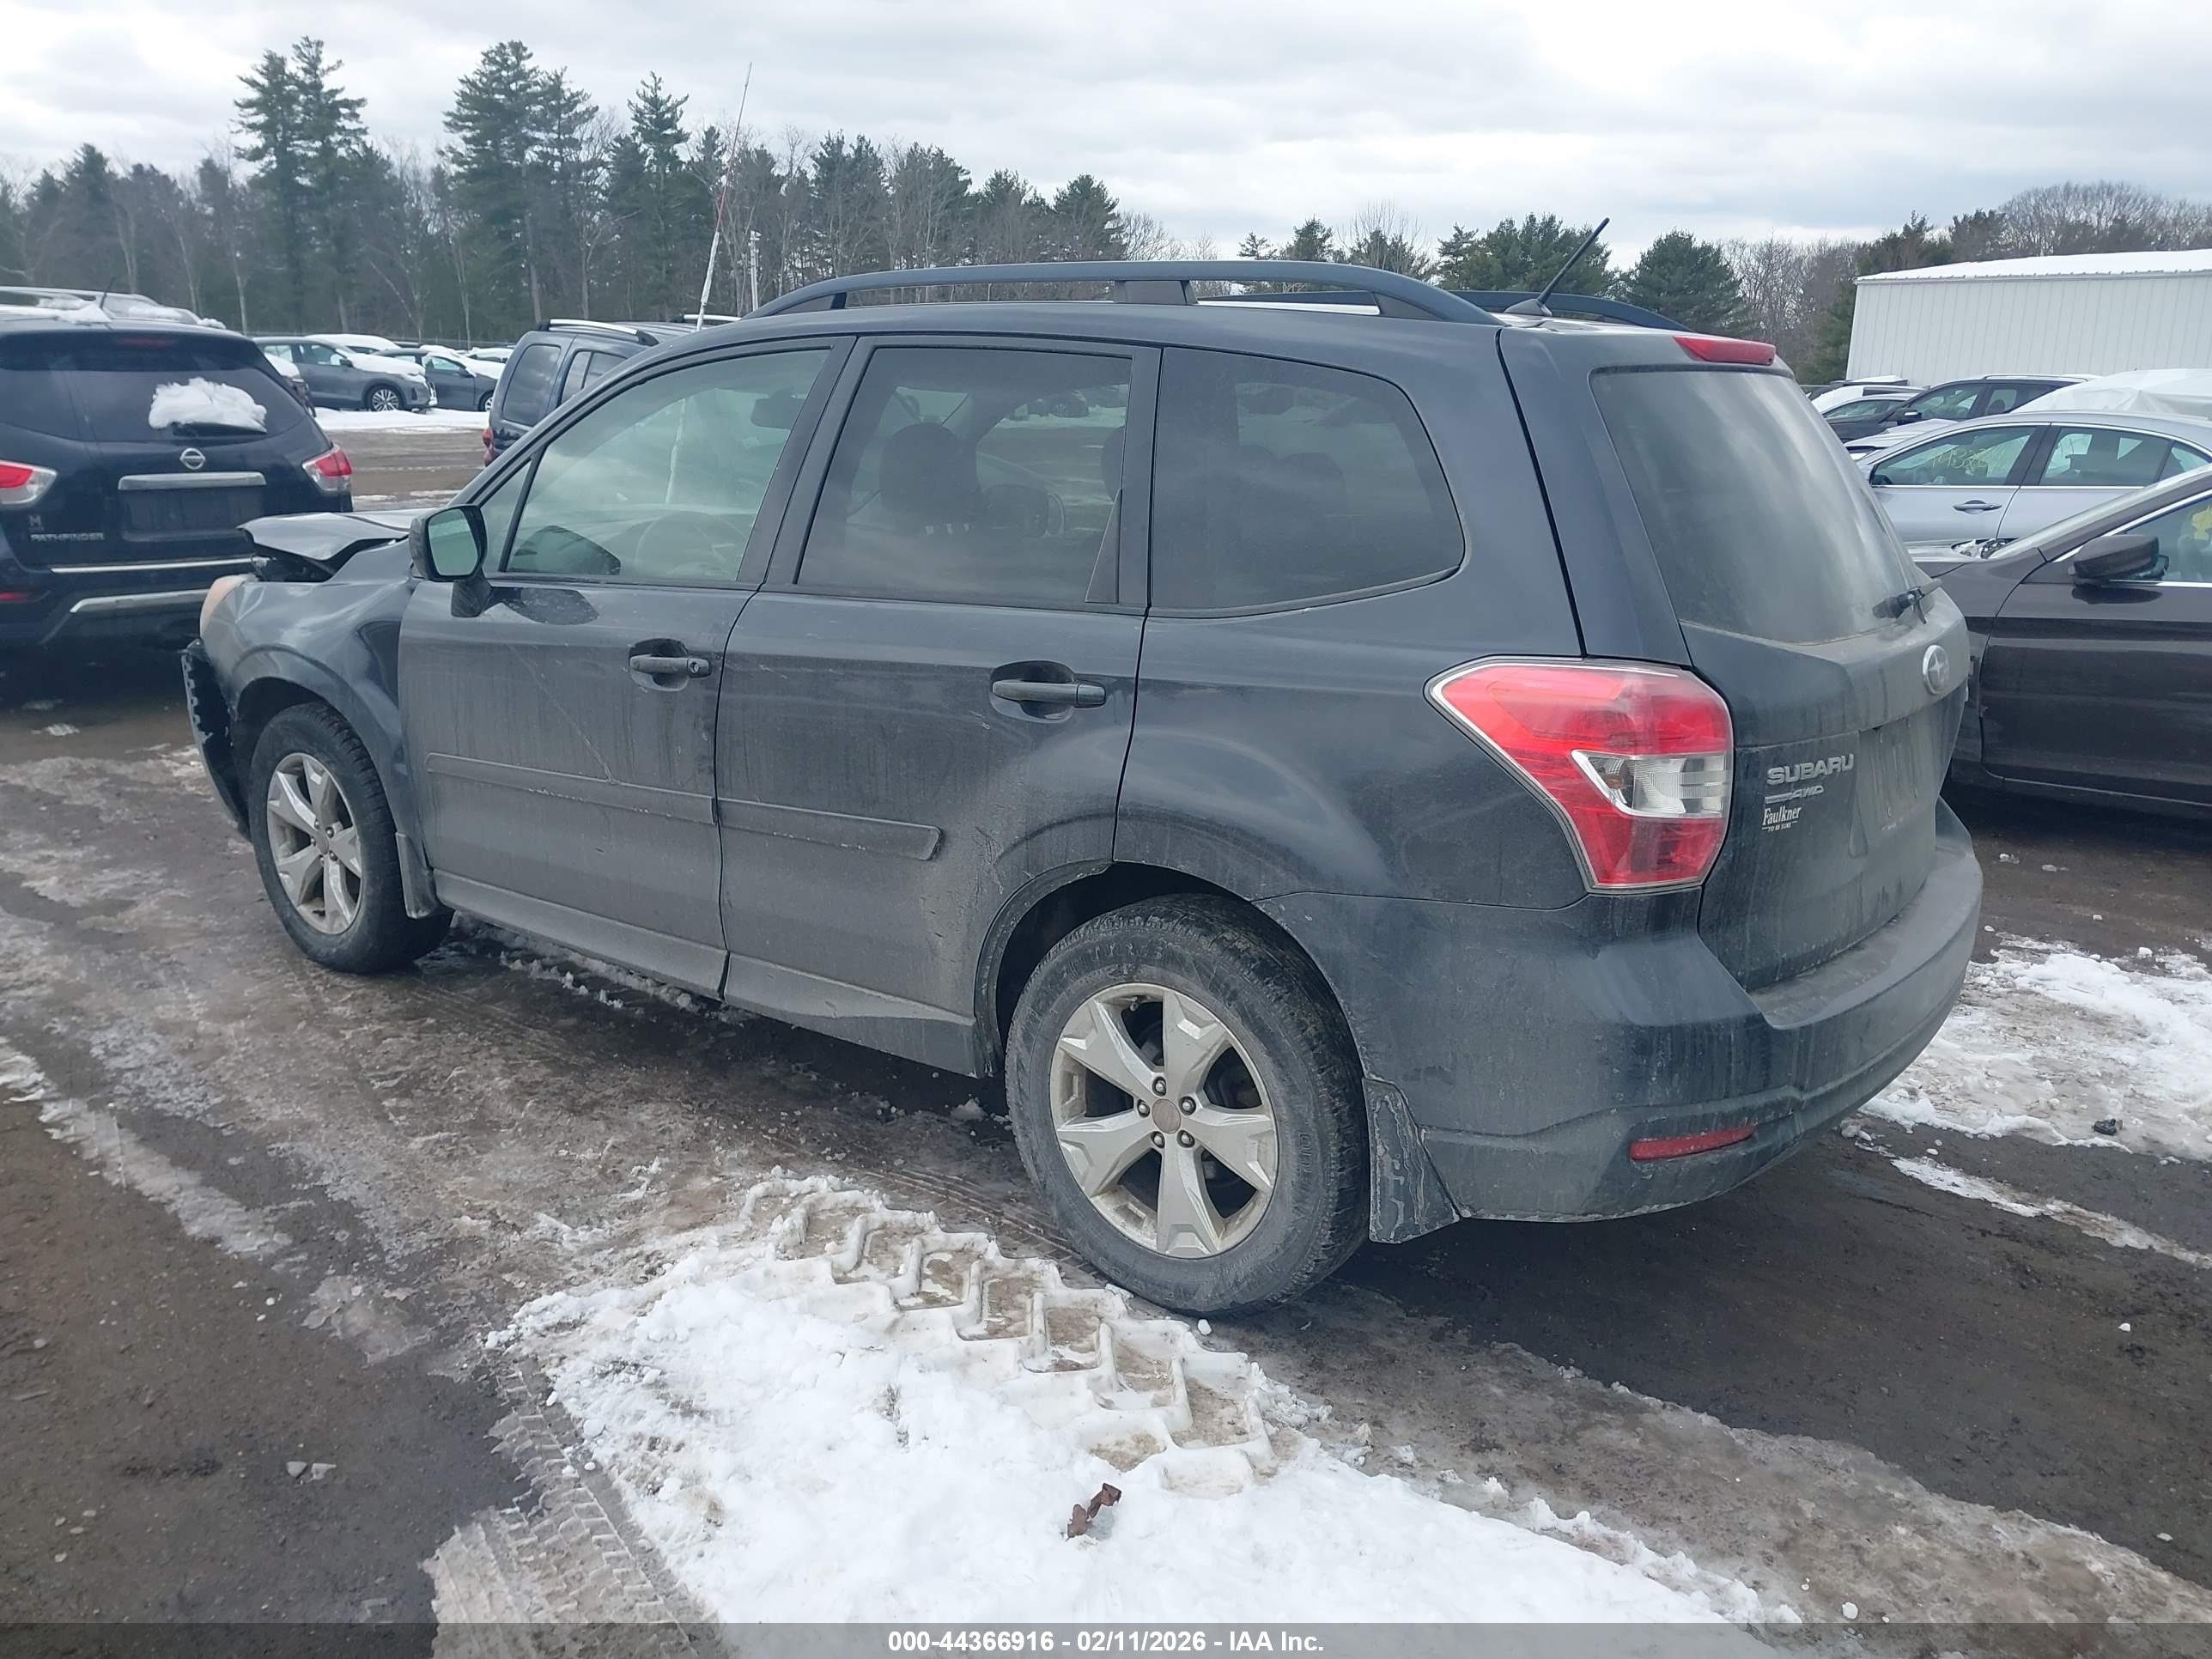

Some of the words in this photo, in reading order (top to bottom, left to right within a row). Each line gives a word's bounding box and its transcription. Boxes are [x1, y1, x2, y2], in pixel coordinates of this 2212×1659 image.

[1766, 753, 1855, 785] SUBARU
[1790, 785, 1825, 799] AWD
[1762, 805, 1802, 826] Faulkner
